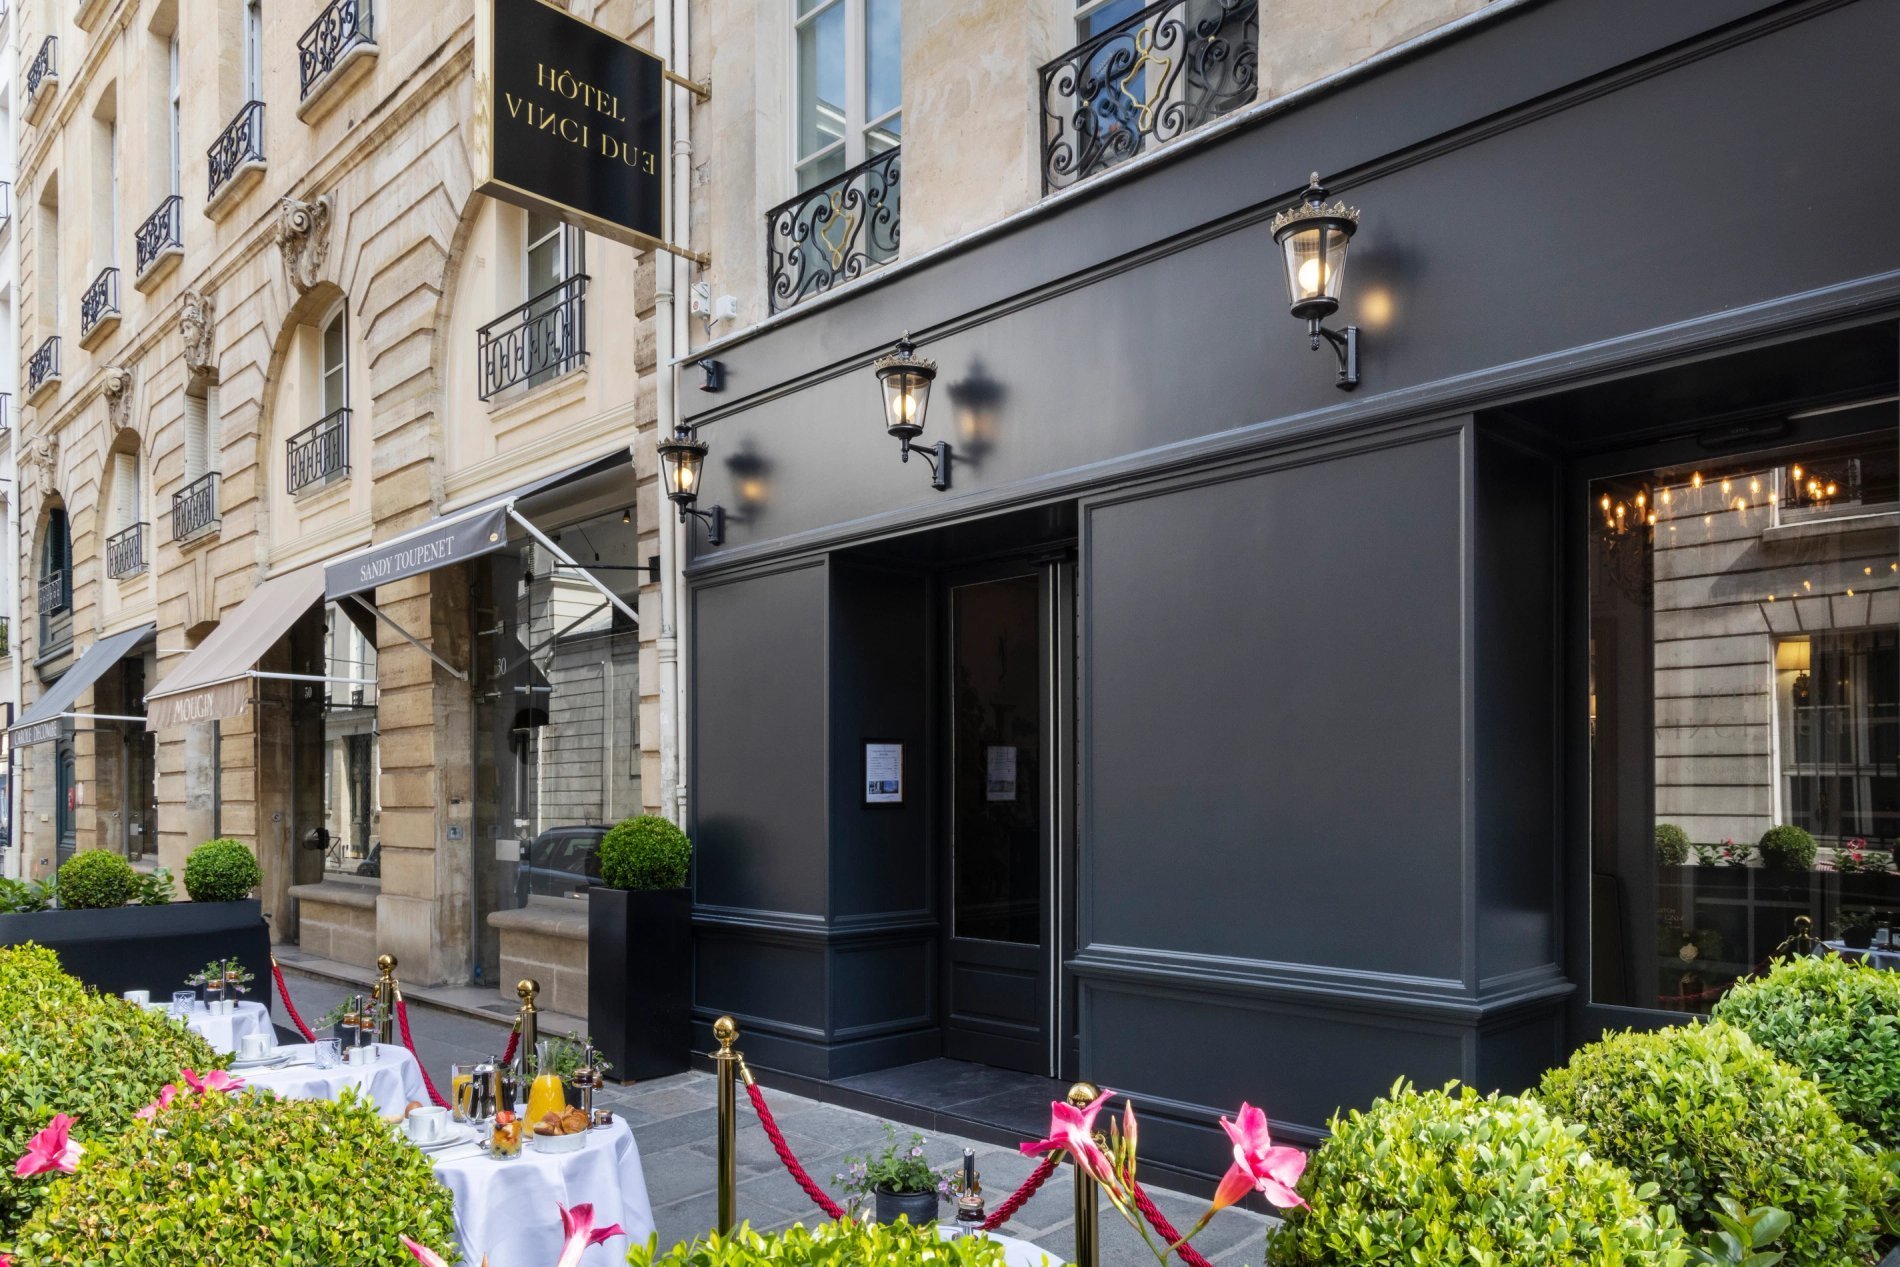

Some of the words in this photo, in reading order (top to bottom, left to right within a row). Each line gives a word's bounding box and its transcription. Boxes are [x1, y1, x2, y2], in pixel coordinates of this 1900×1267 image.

[537, 63, 626, 122] HÔTEL
[505, 92, 588, 148] VINCI
[601, 133, 655, 175] DUE
[360, 556, 393, 582] SANDY
[395, 535, 455, 572] TOUPENET
[173, 693, 214, 723] MOUGIN
